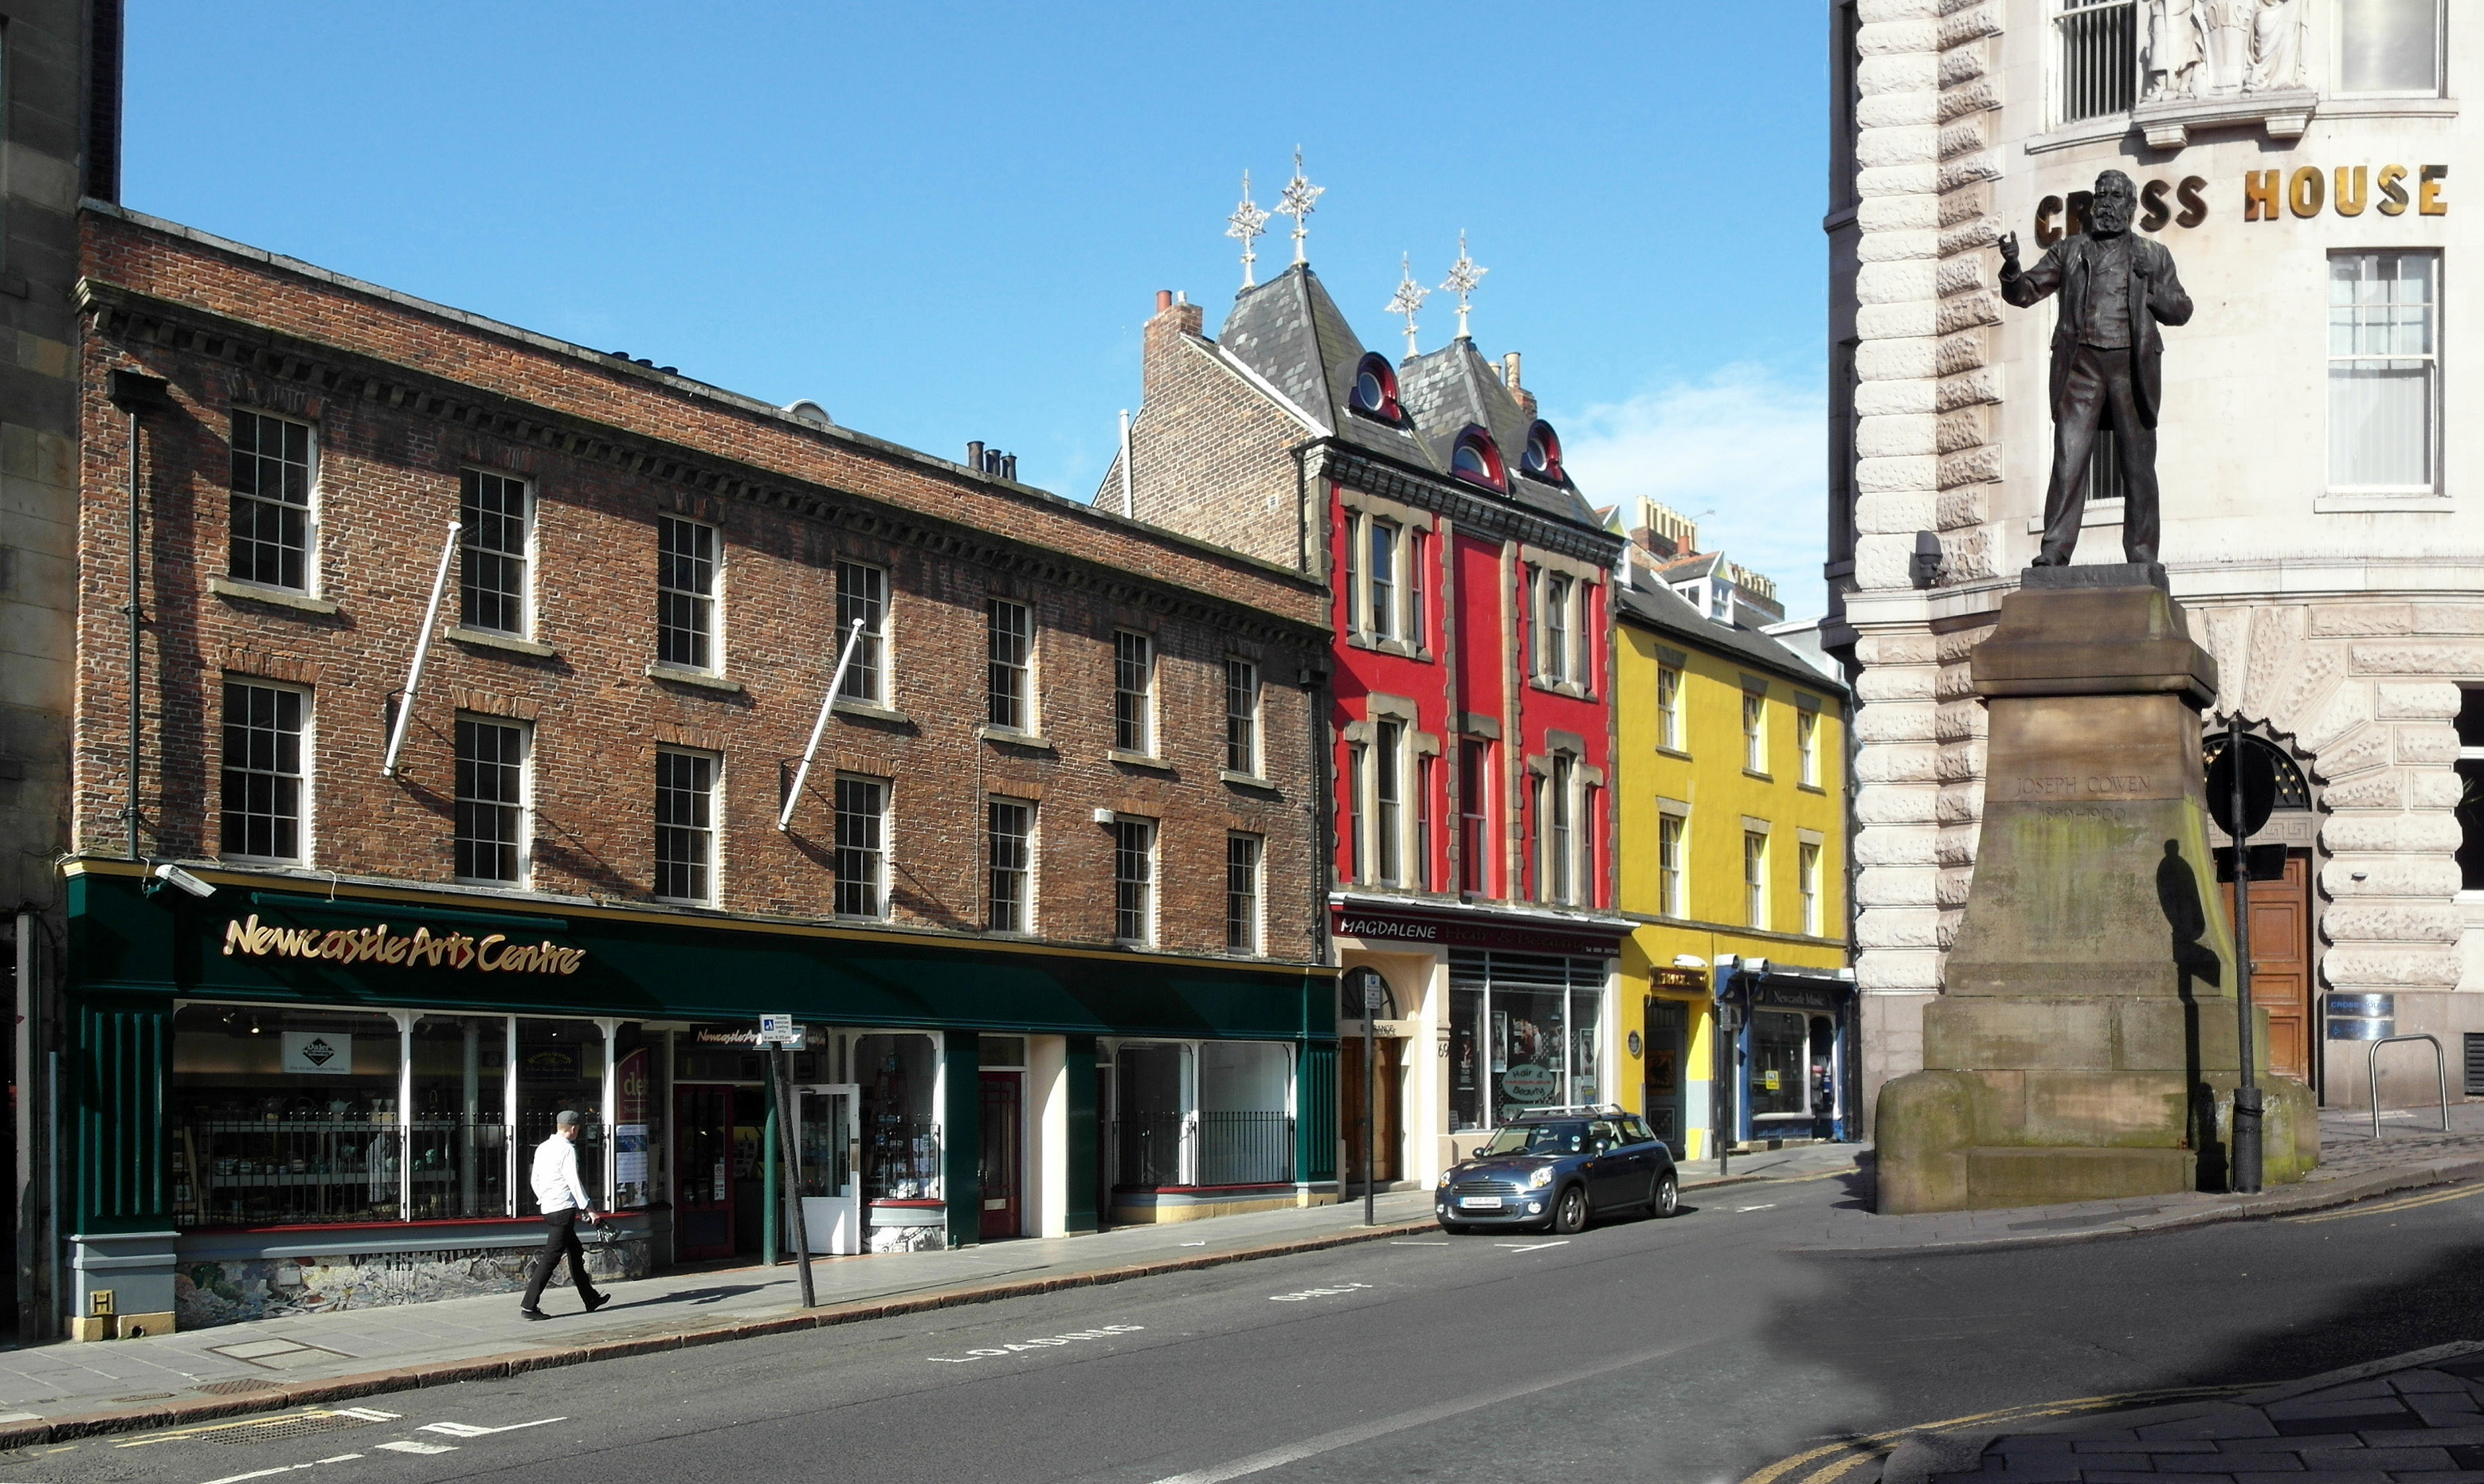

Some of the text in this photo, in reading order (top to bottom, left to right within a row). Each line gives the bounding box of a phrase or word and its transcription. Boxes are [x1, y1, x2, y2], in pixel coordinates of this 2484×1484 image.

[2035, 164, 2449, 249] CRSS HOUSE
[2016, 776, 2150, 796] JOSEPH COWEN
[1340, 918, 1436, 938] MAGDALENE
[223, 914, 586, 974] Newcastle Arts Centre
[1438, 1043, 1449, 1058] 69
[1513, 1068, 1532, 1078] Hair
[1514, 1086, 1545, 1096] Beauty
[1268, 1282, 1373, 1302] ONLY
[93, 1293, 109, 1313] H
[927, 1324, 1145, 1362] LOADING
